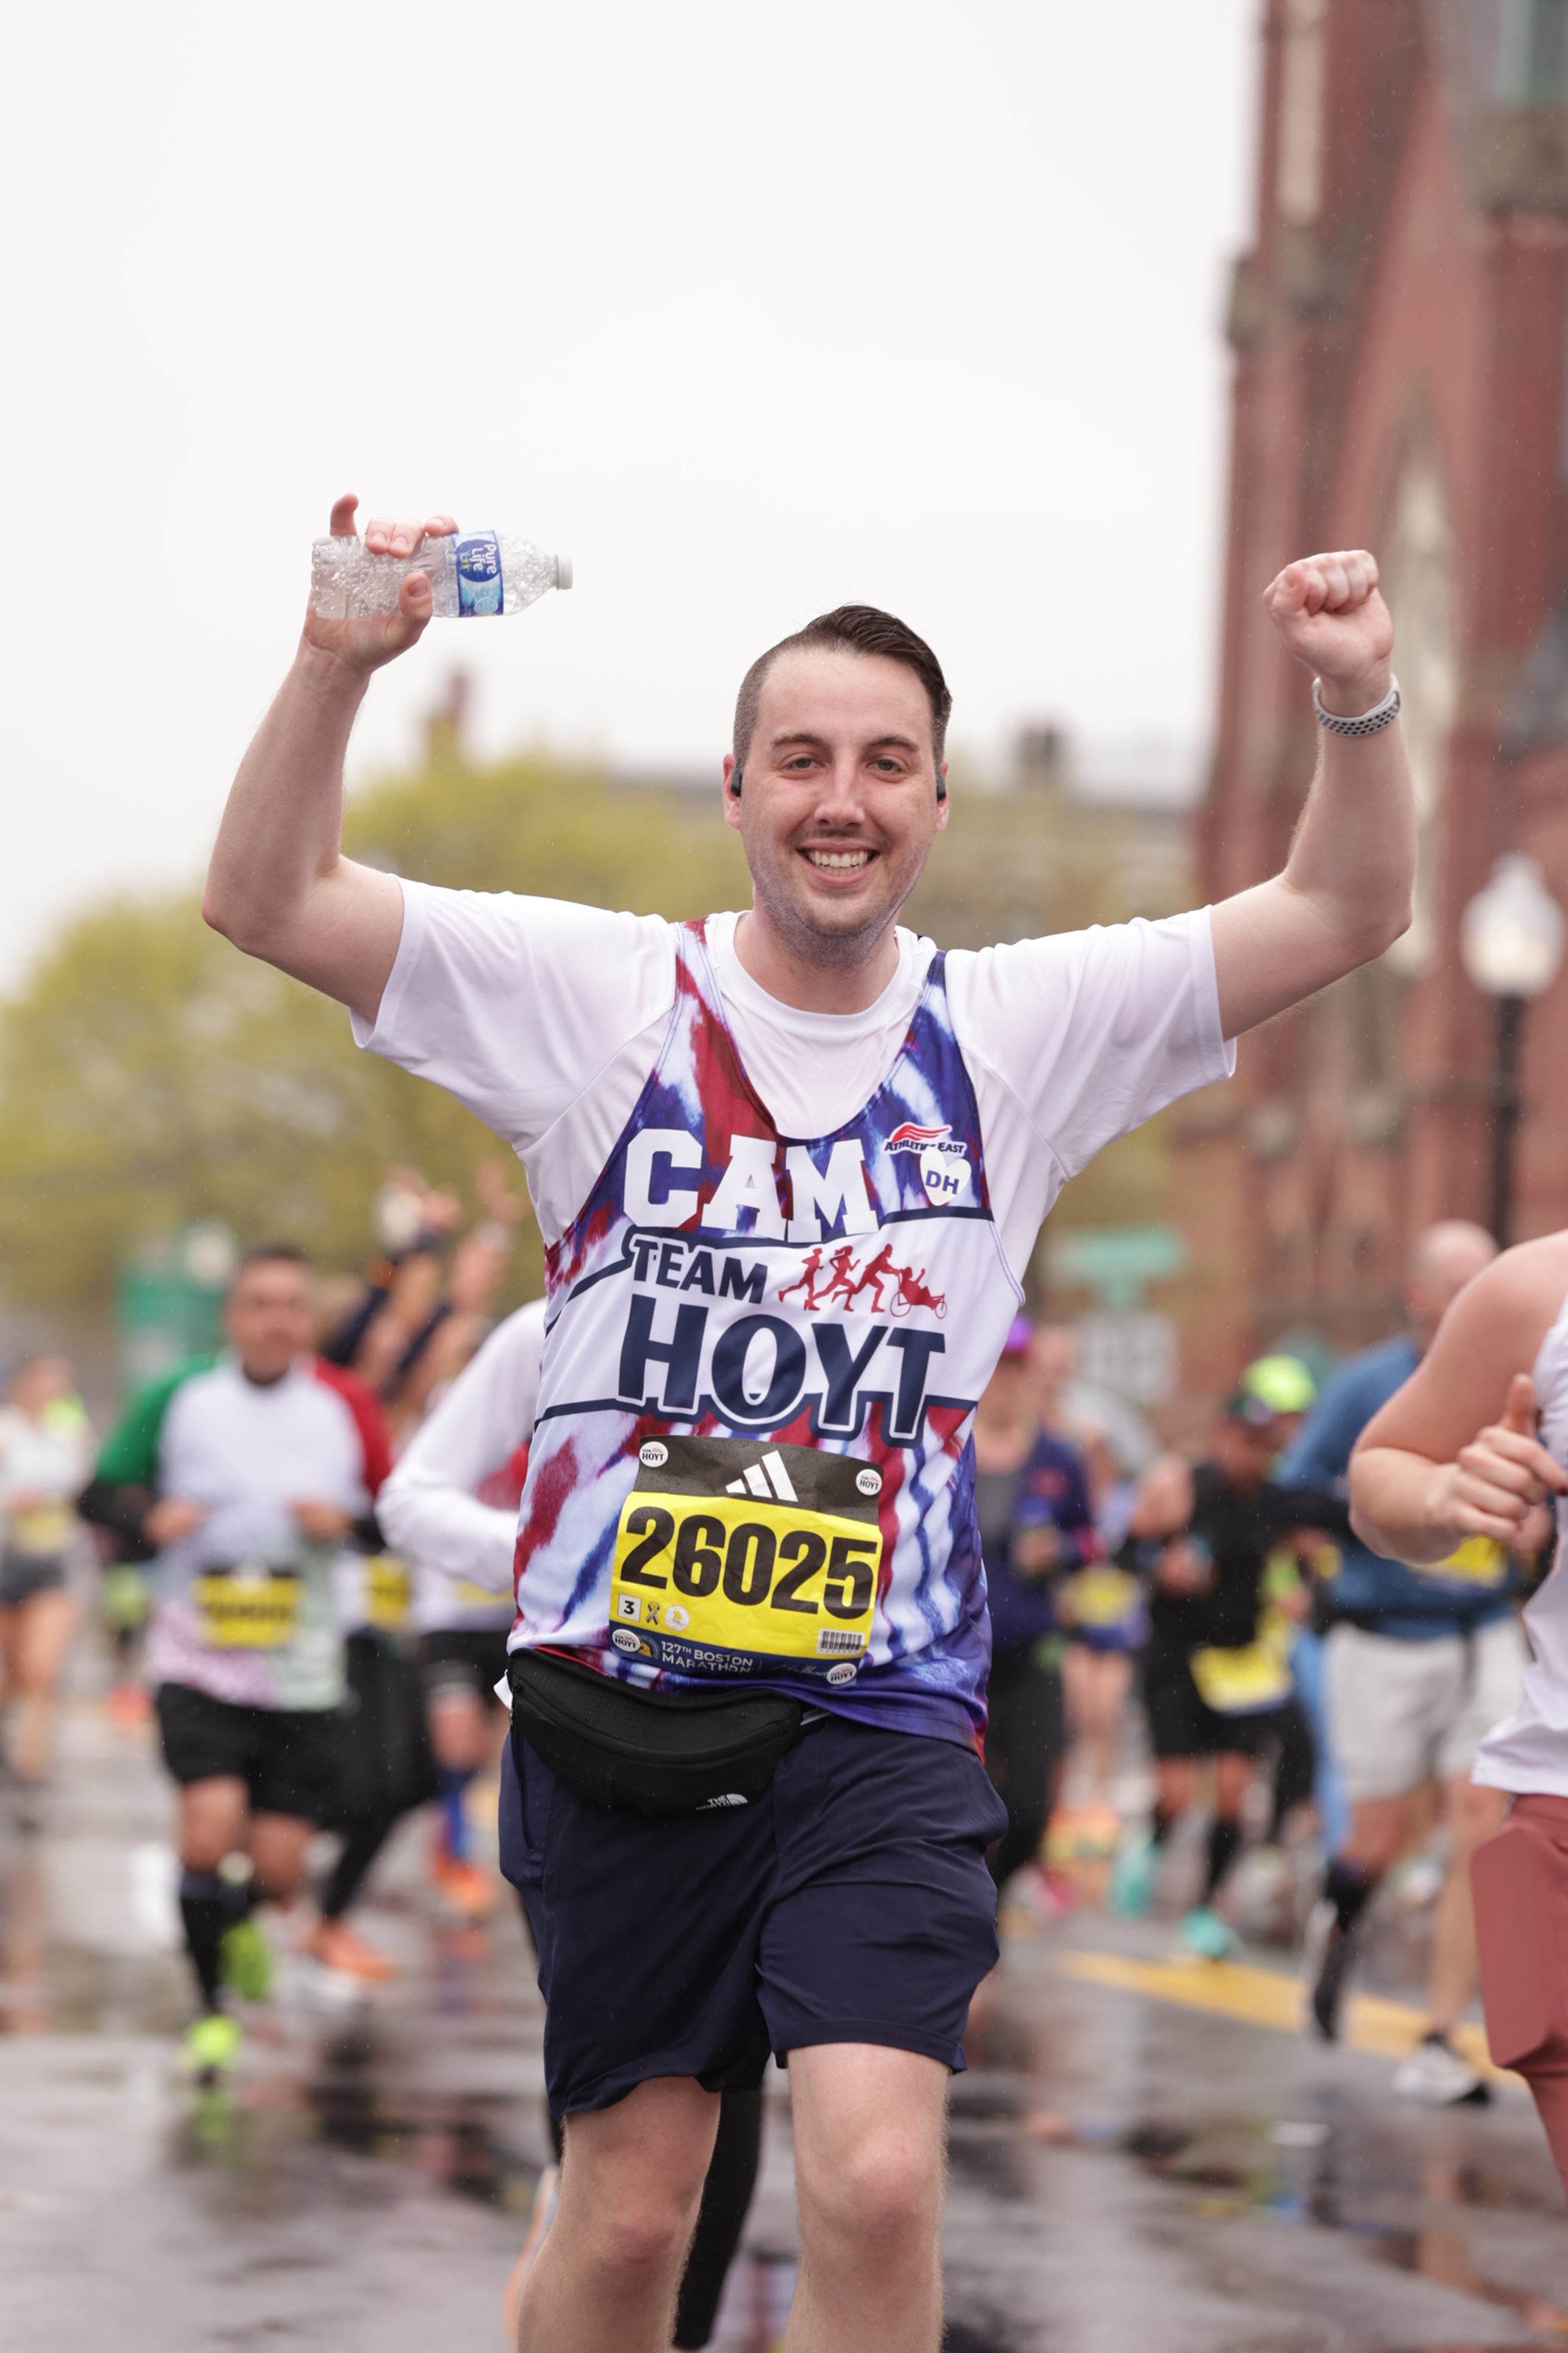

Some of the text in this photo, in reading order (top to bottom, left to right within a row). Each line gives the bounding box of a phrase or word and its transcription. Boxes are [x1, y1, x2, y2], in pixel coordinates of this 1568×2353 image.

[470, 548, 485, 571] Life
[484, 544, 497, 574] Pure
[937, 1143, 964, 1154] EAST
[623, 1128, 880, 1243] CAM
[925, 1170, 959, 1195] DH
[634, 1239, 767, 1304] TEAM
[618, 1293, 945, 1434] HOYT
[642, 1453, 664, 1461] HOYT
[859, 1479, 879, 1490] HOYT
[619, 1506, 878, 1620] 26025
[623, 1600, 634, 1615] 3
[615, 1638, 637, 1649] HOYT
[662, 1652, 751, 1673] MARATHON
[694, 1649, 753, 1666] BOSTON
[831, 1671, 853, 1682] HOYT
